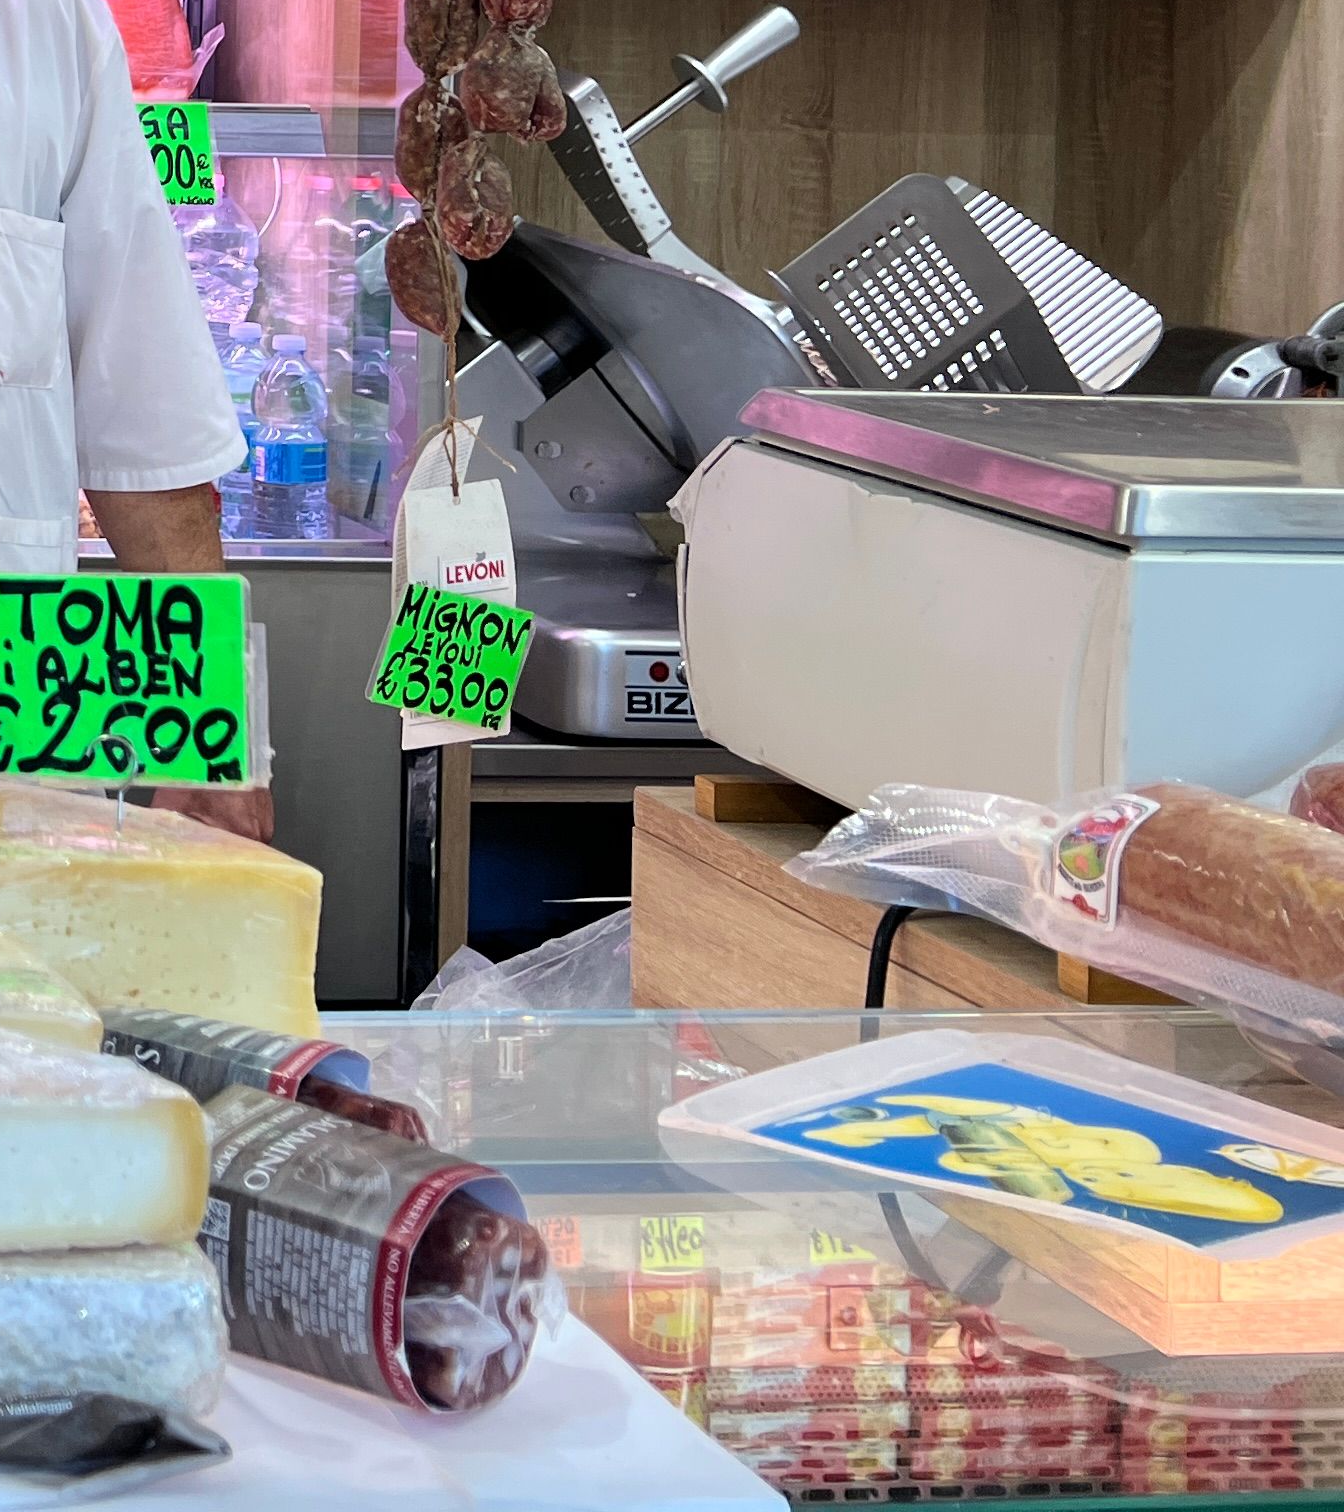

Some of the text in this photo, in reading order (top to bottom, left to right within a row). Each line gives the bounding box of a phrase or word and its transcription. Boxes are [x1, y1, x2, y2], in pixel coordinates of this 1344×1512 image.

[445, 559, 506, 585] LEVONI
[37, 644, 204, 699] ALBEN
[626, 691, 692, 716] BIZ
